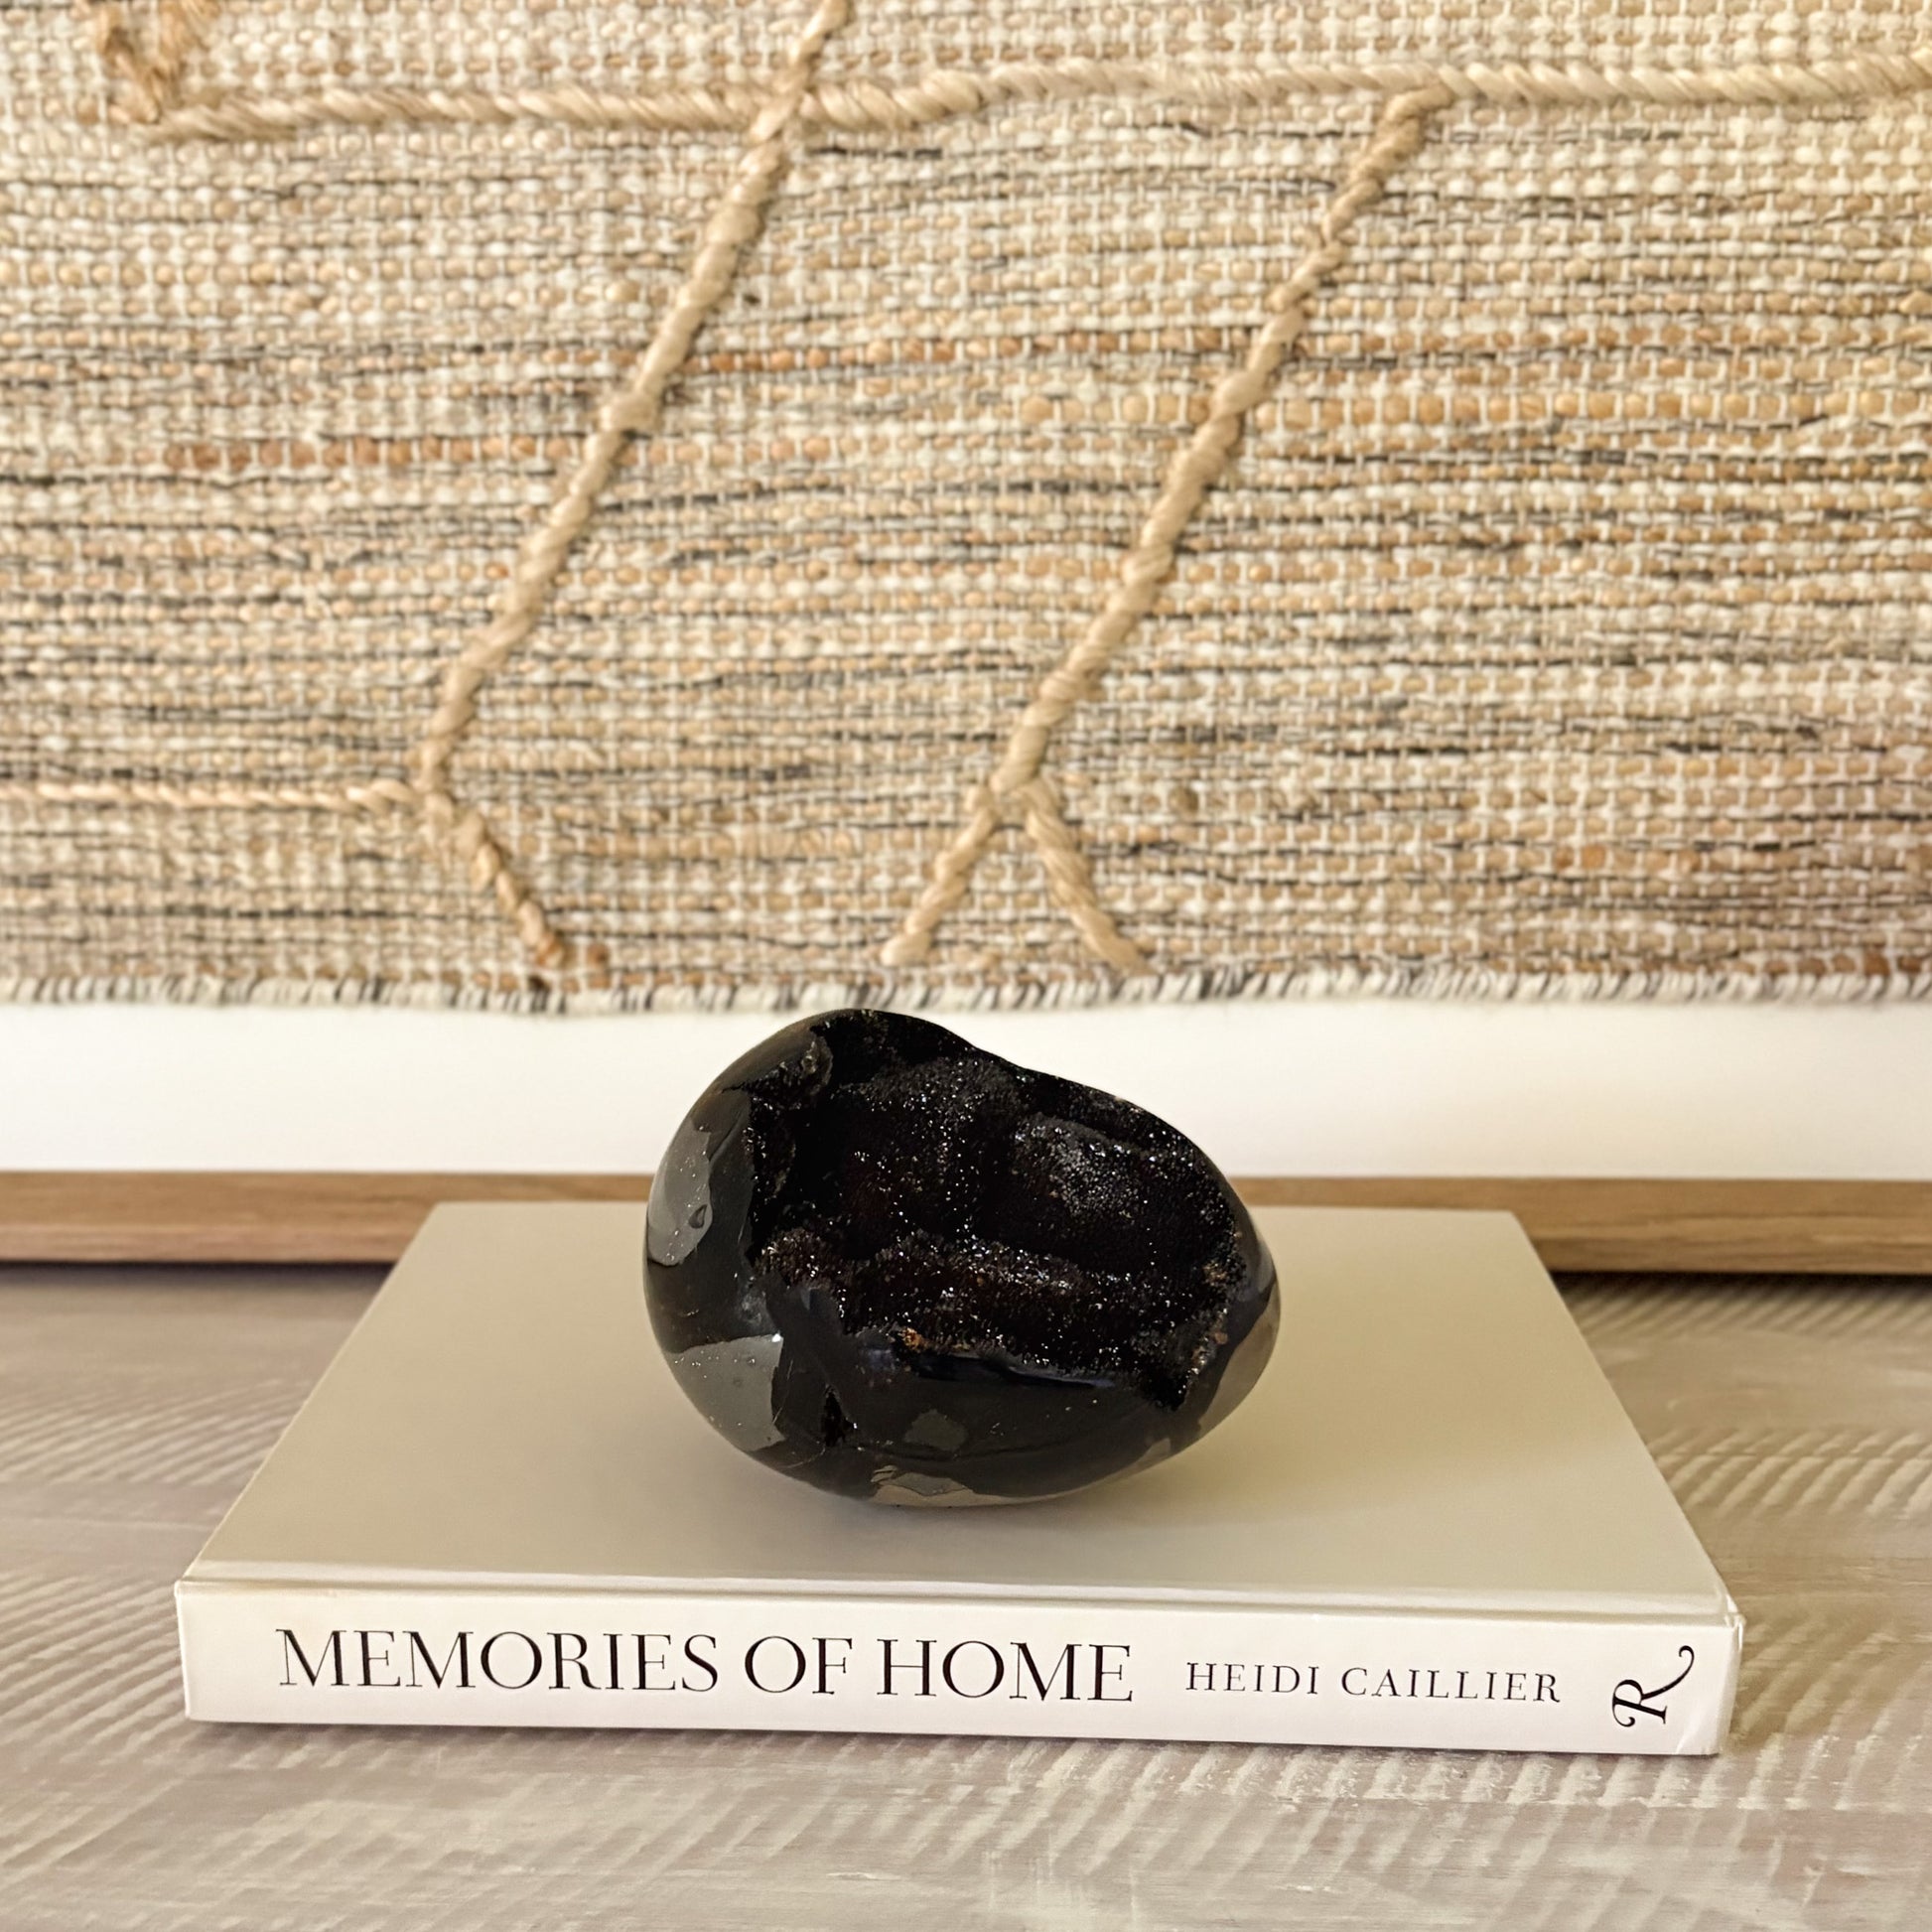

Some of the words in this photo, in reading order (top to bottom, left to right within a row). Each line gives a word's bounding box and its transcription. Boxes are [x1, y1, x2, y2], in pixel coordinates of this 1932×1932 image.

[276, 1628, 718, 1693] MEMORIES
[744, 1635, 854, 1696] OF
[877, 1638, 1133, 1702] HOME
[1185, 1662, 1320, 1695] HEIDI
[1341, 1667, 1562, 1704] CAILLIER
[1611, 1645, 1695, 1727] R
